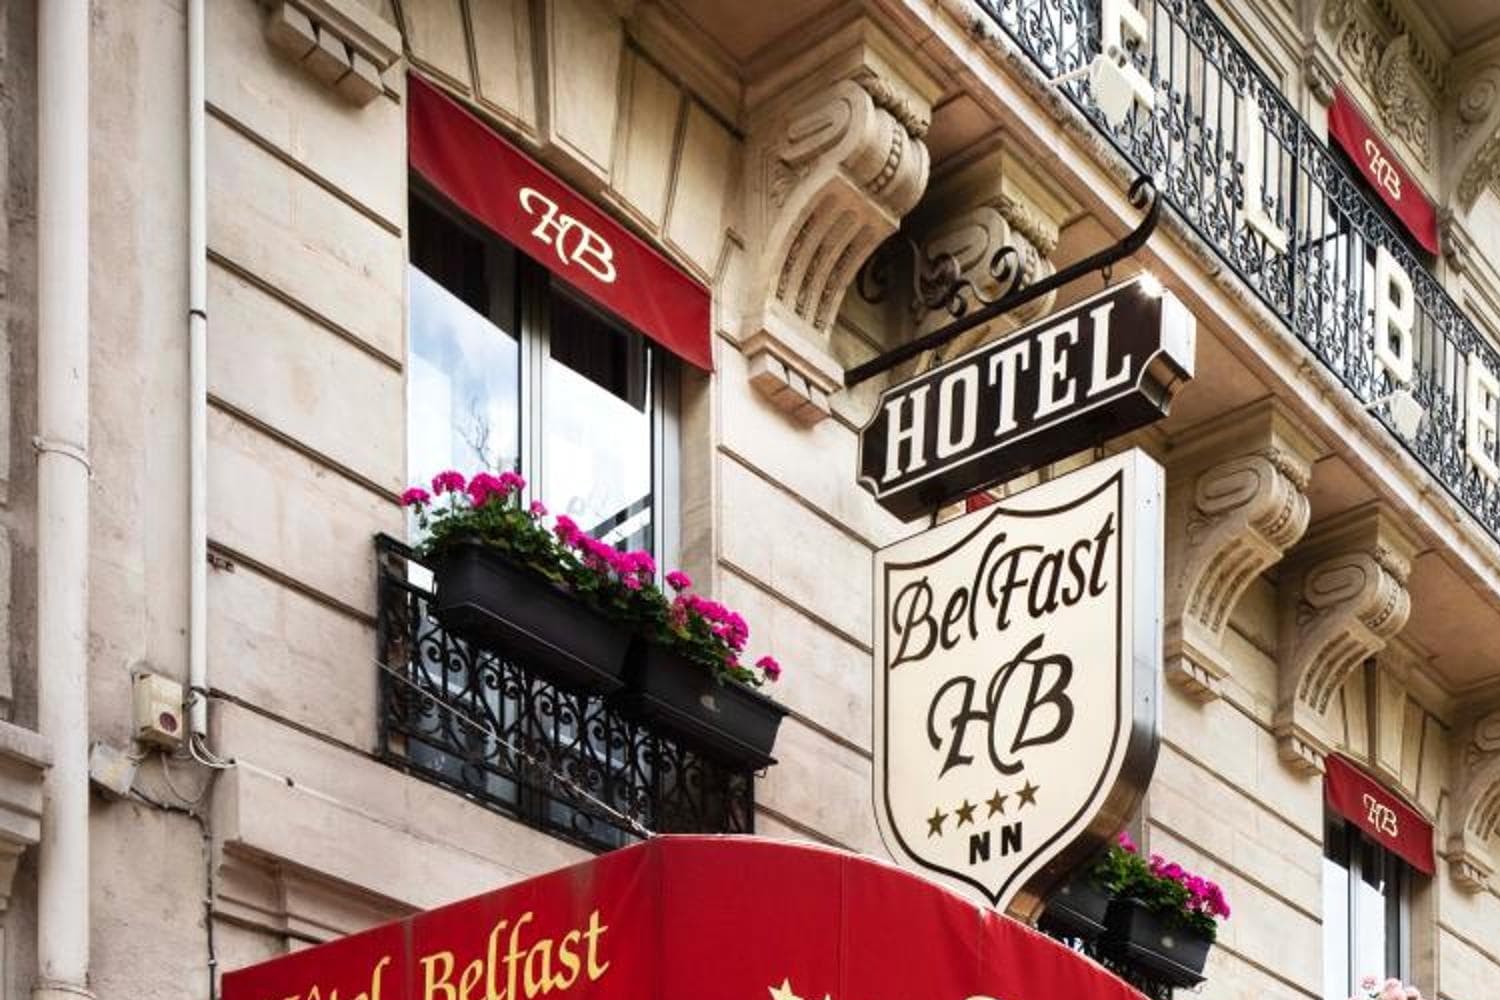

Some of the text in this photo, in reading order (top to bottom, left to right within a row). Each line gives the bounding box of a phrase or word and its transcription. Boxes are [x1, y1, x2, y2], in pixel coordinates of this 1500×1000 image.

[519, 186, 617, 284] HB
[881, 300, 1133, 482] HOTEL
[926, 633, 1074, 782] HB
[967, 821, 1024, 866] NN
